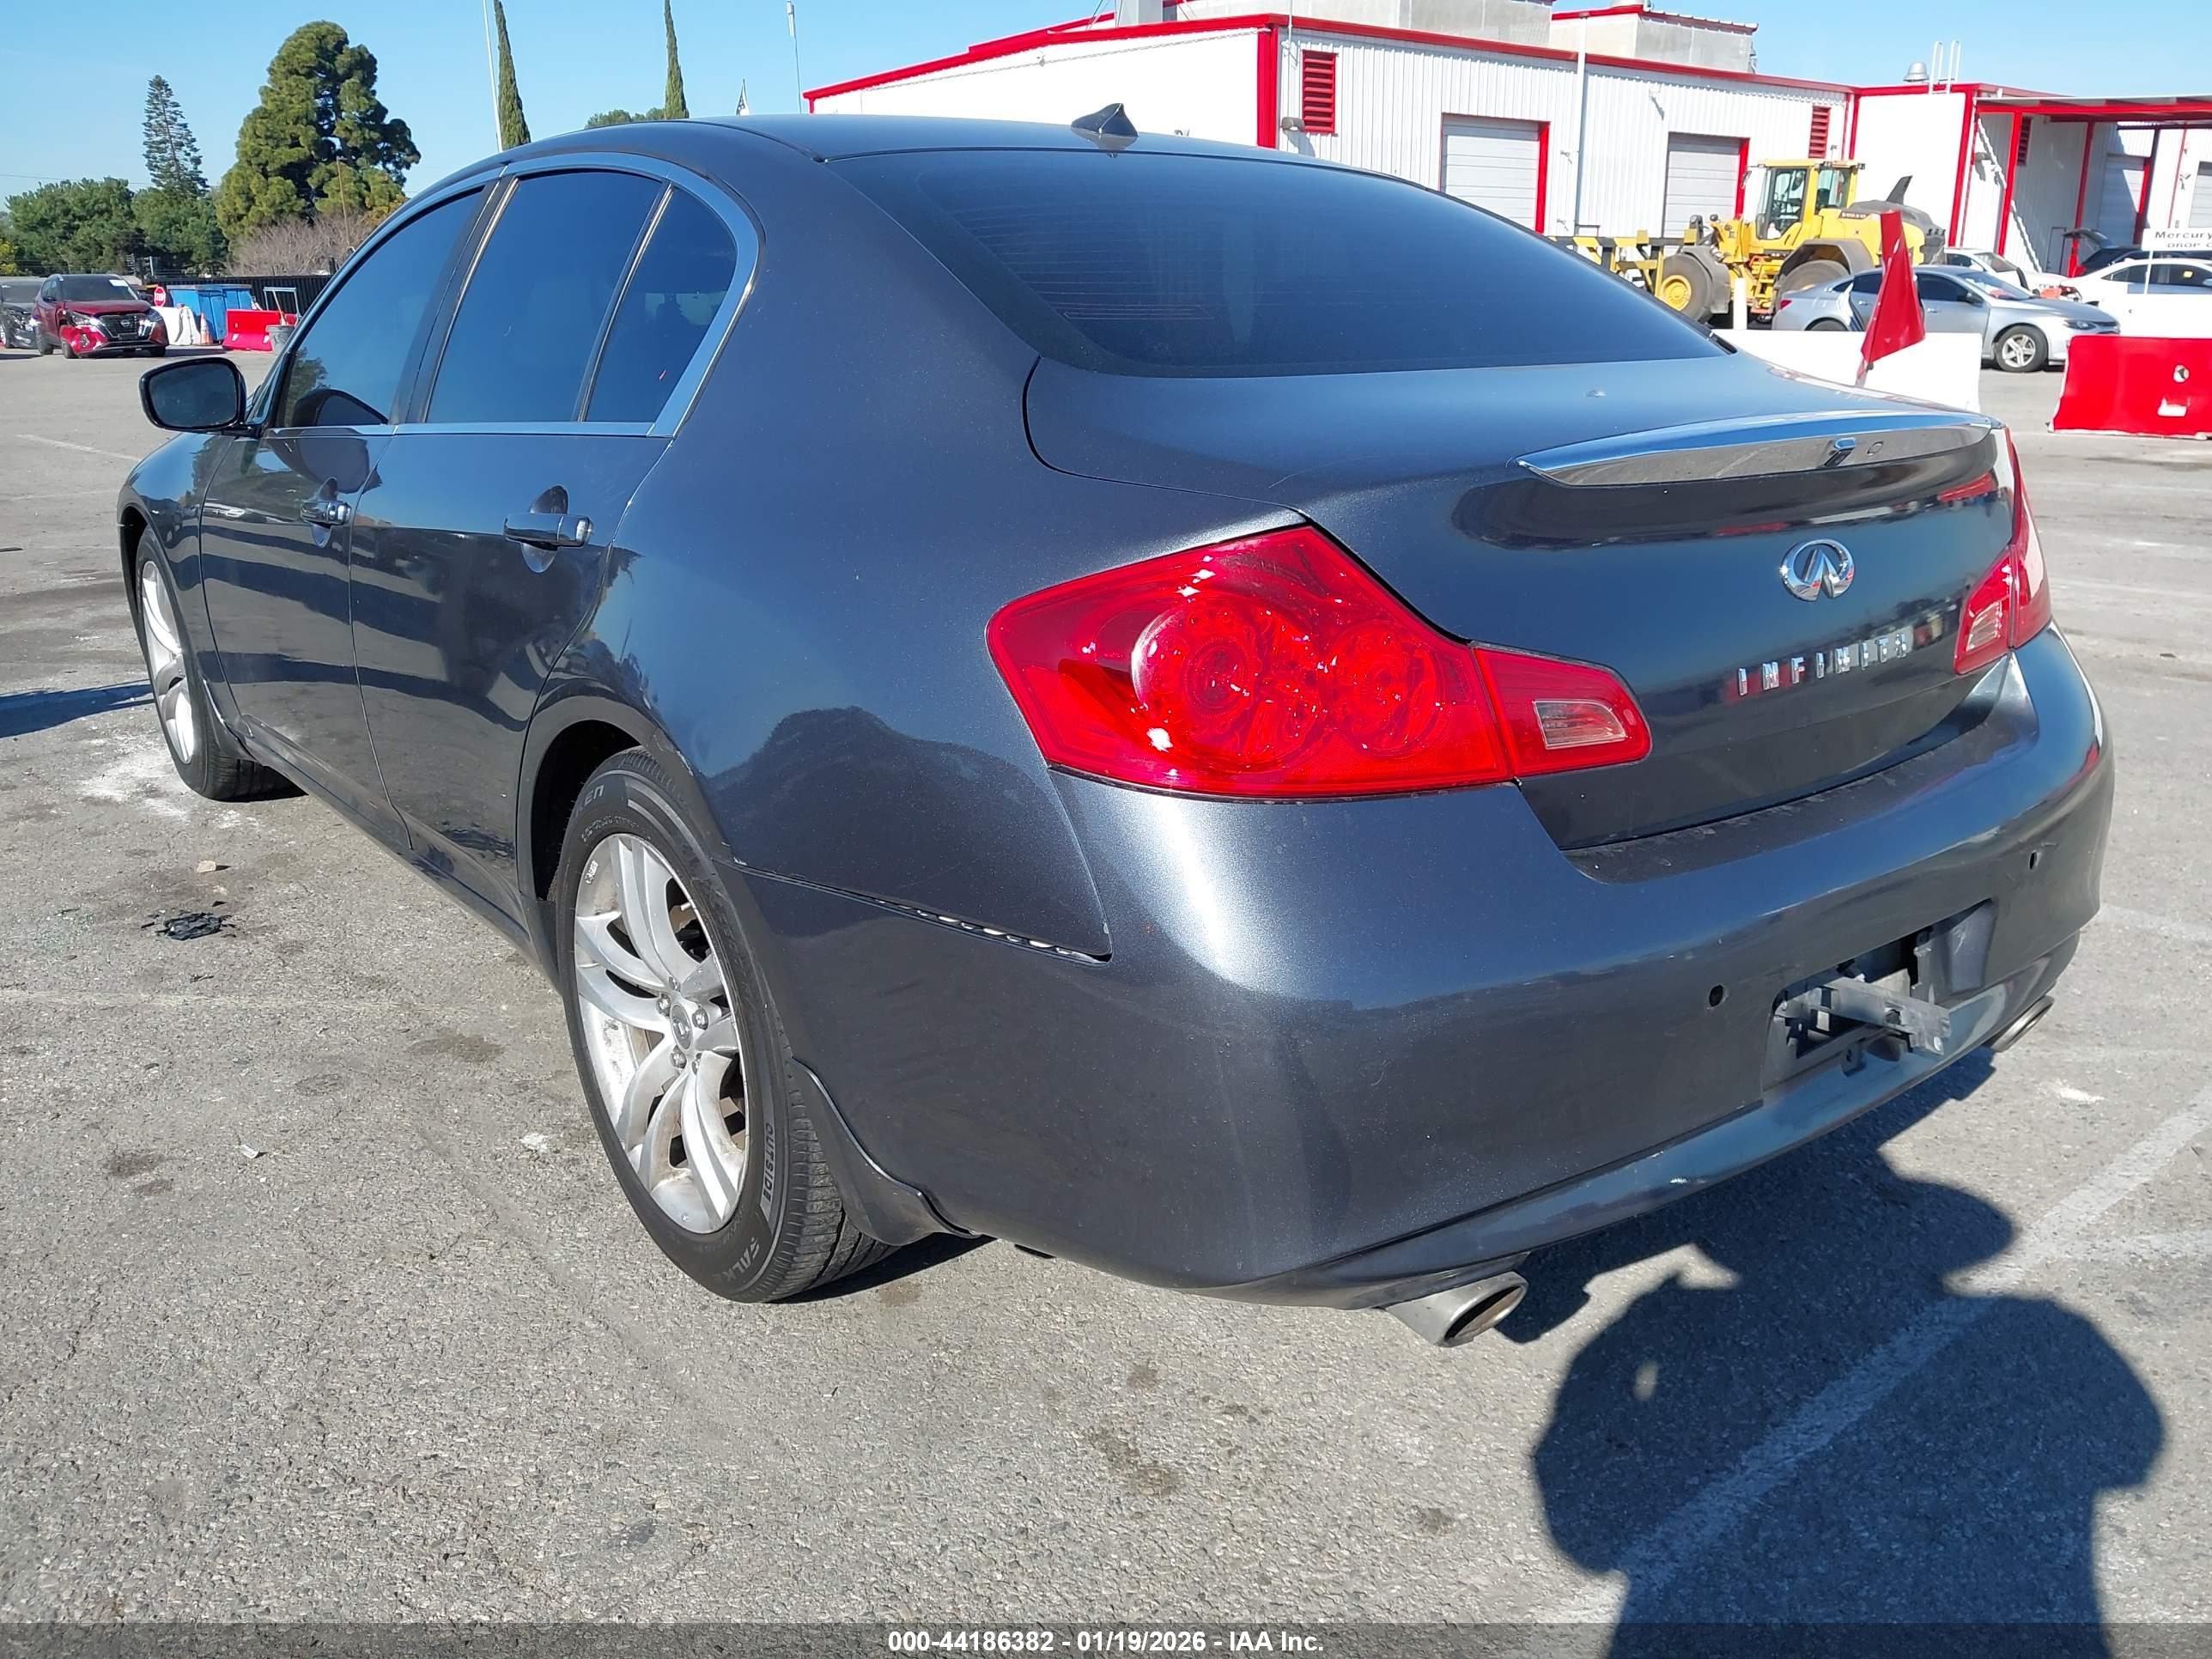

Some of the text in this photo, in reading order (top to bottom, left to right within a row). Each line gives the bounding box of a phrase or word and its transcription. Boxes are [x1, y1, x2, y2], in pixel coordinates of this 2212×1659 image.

[2155, 231, 2212, 240] Mercury
[155, 293, 165, 301] STOP
[1737, 633, 1908, 696] INFINITI
